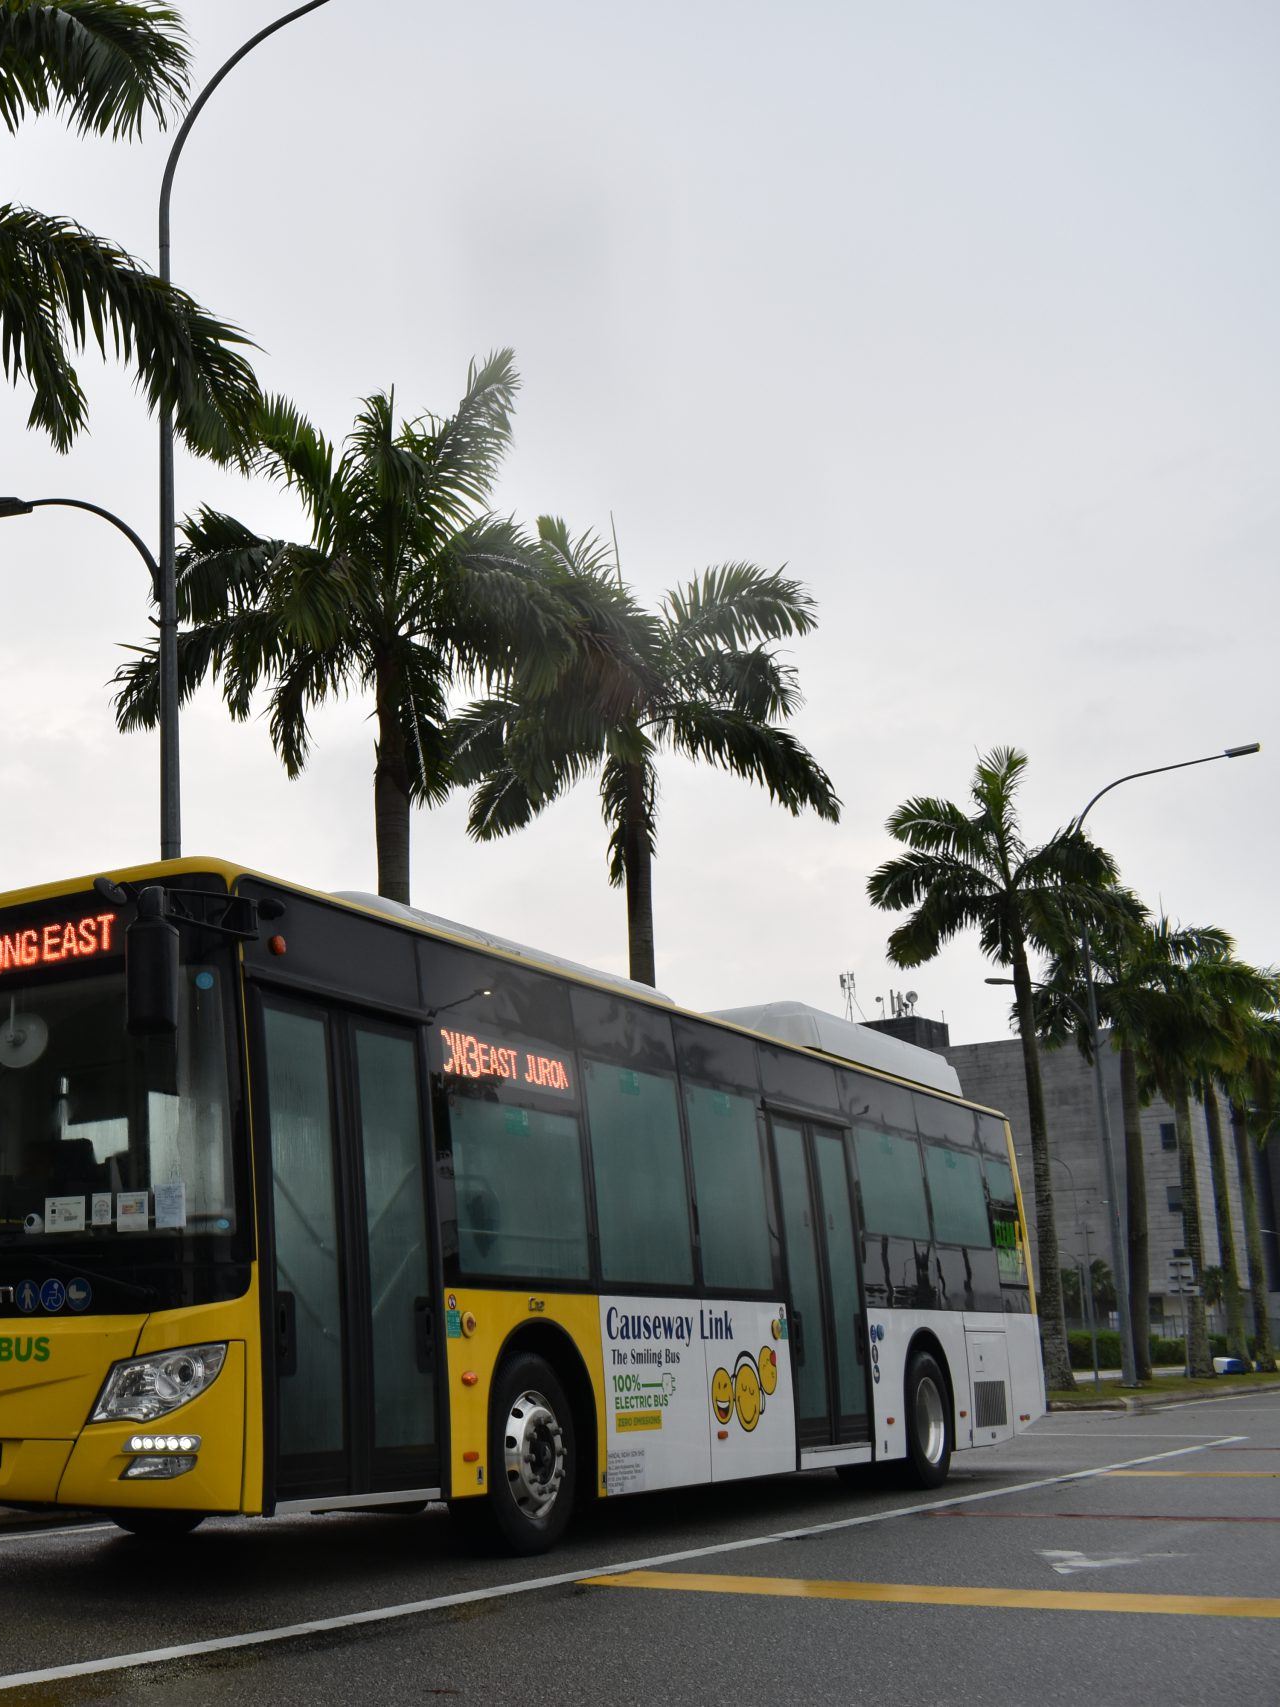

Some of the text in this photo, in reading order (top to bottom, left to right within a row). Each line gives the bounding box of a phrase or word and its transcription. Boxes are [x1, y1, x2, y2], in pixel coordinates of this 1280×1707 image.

[42, 914, 115, 962] EAST
[478, 1043, 517, 1080] EAST
[606, 1306, 734, 1347] Causeway Link
[611, 1348, 681, 1367] The Smiling Bus
[613, 1374, 641, 1393] 100%
[615, 1394, 669, 1410] ELECTRIC BUS
